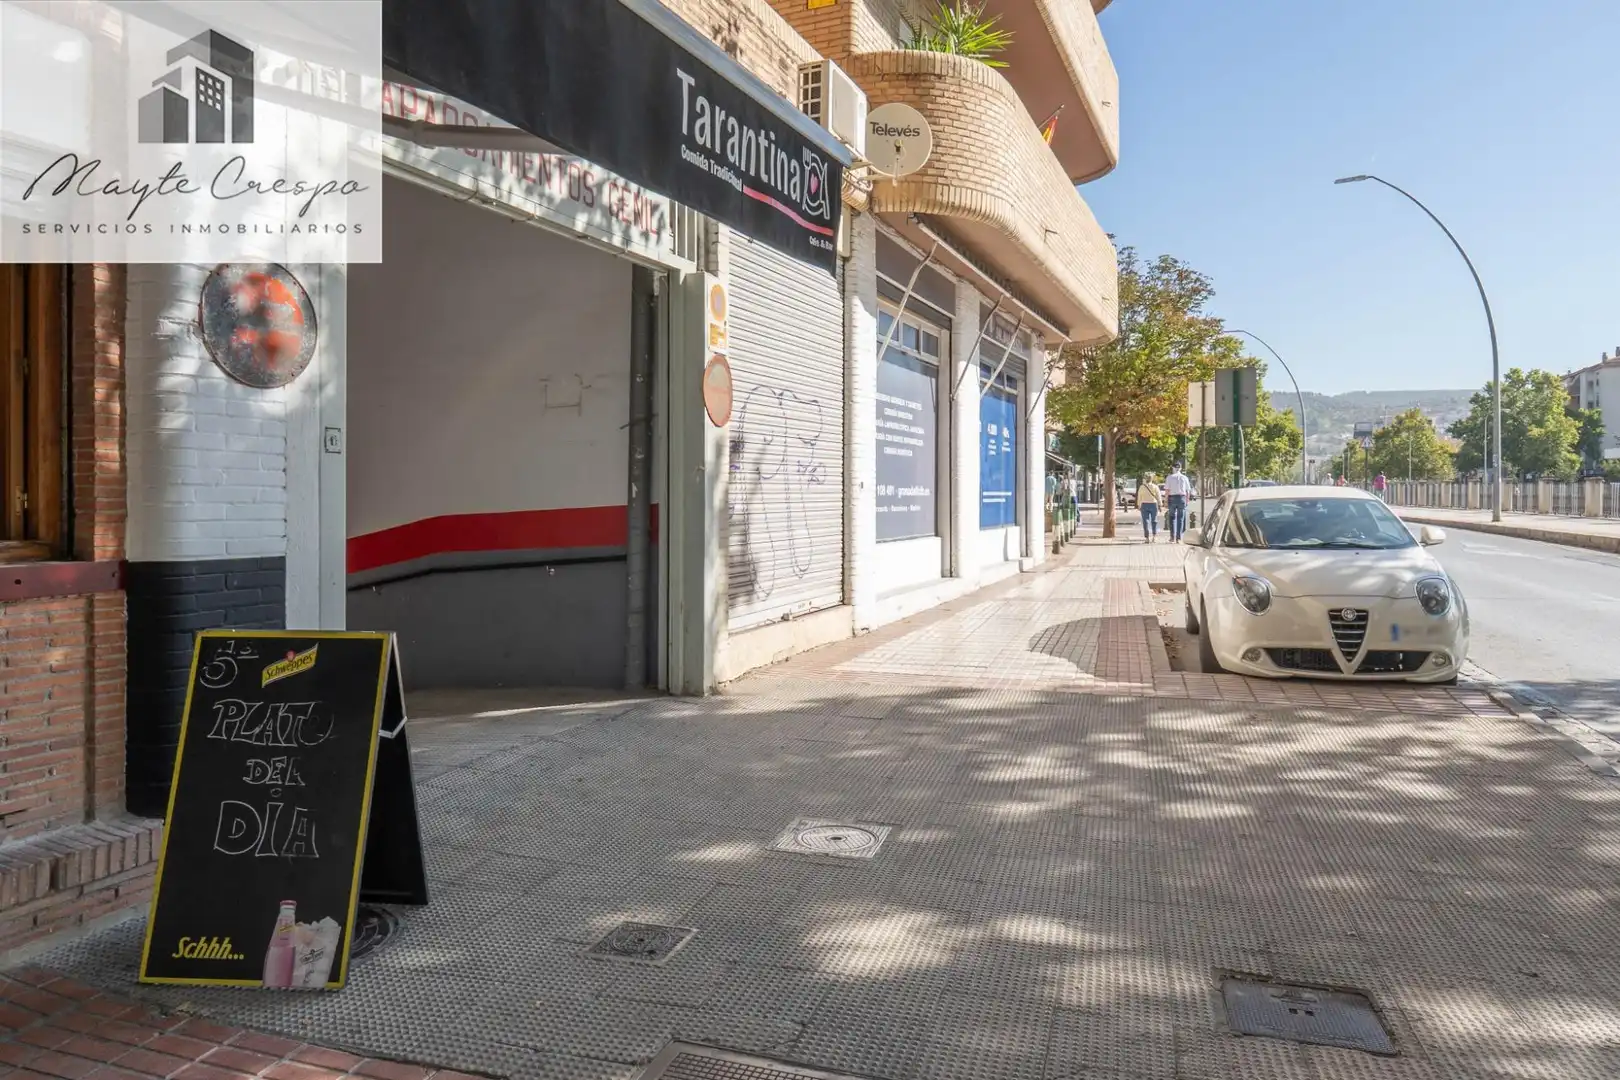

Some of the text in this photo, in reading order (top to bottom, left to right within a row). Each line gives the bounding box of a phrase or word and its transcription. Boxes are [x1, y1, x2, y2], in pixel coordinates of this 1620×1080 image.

[677, 67, 801, 204] Tarantina
[869, 121, 921, 138] Televés
[681, 144, 709, 172] Comida
[266, 652, 314, 679] Schweppes
[172, 936, 245, 961] Schhh...
